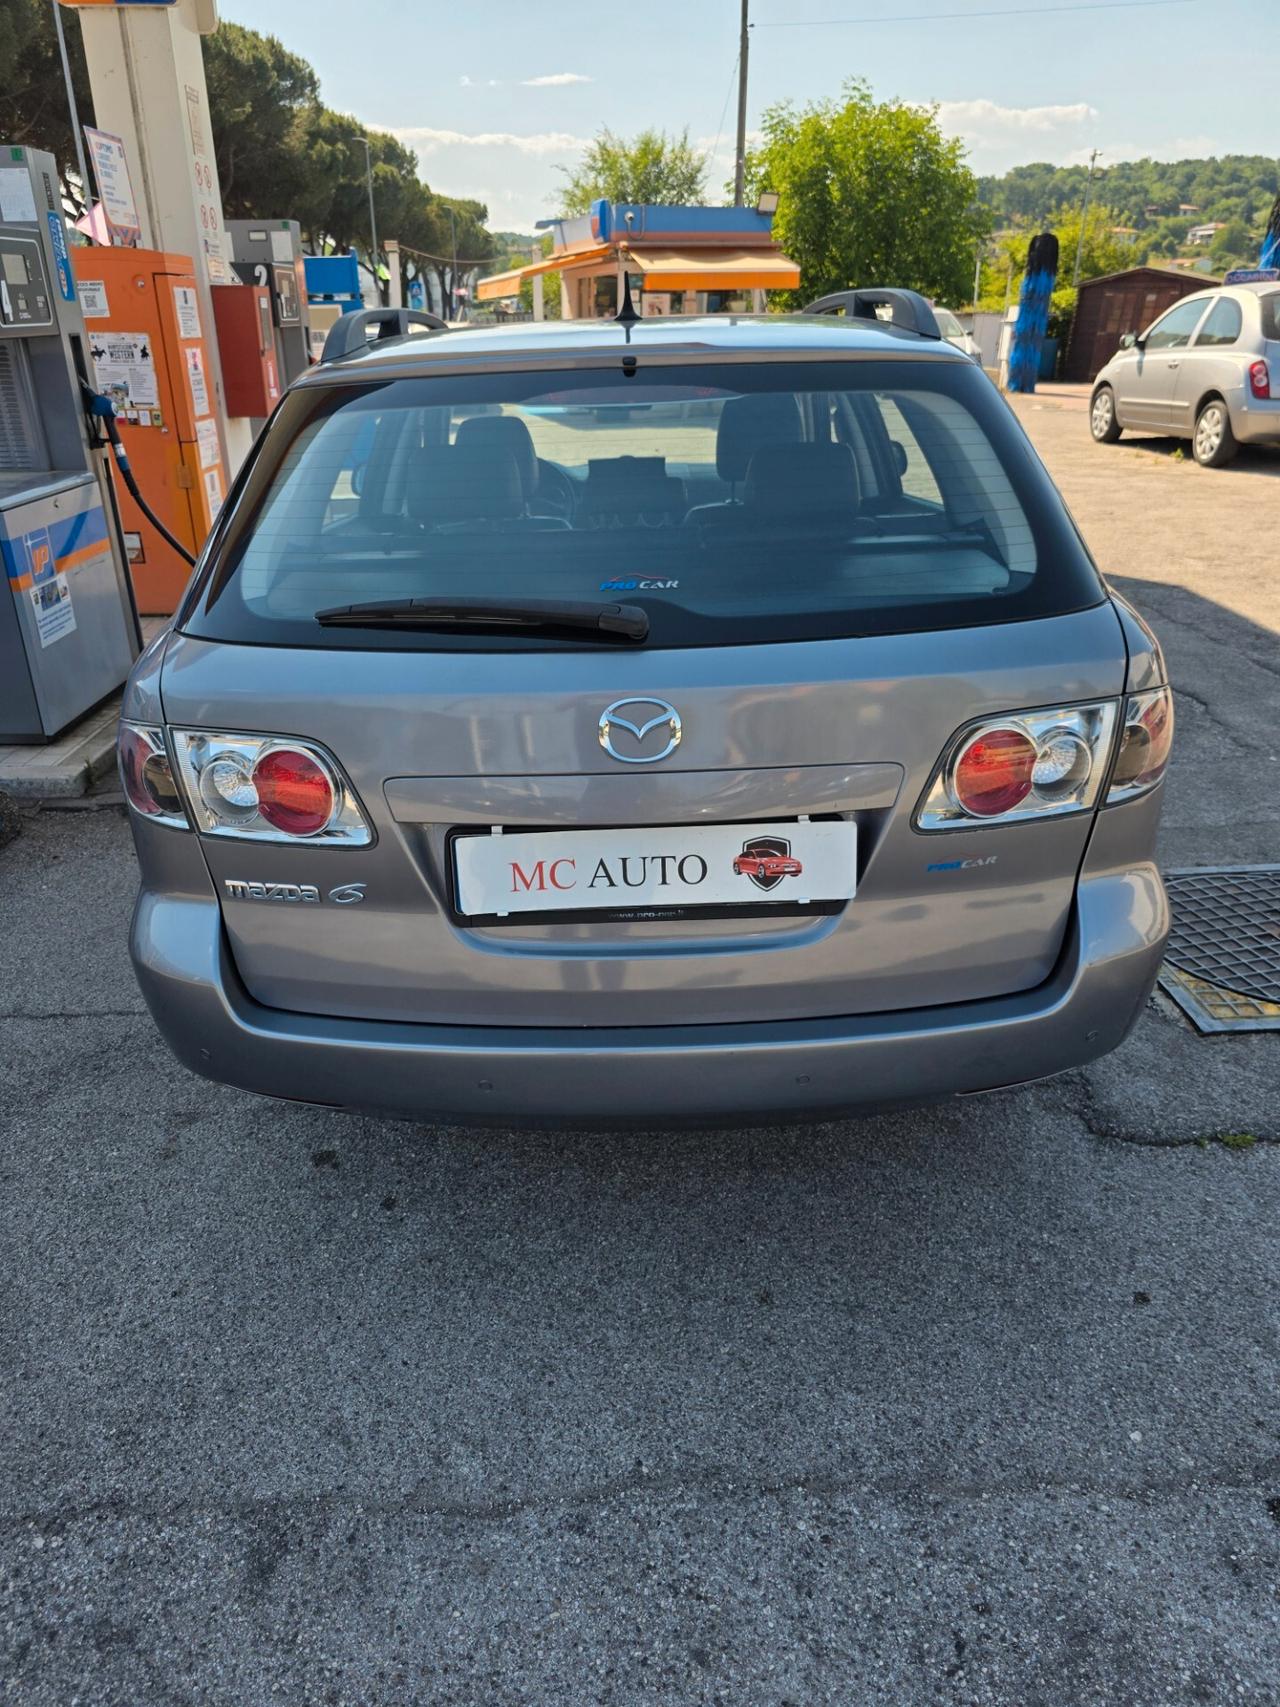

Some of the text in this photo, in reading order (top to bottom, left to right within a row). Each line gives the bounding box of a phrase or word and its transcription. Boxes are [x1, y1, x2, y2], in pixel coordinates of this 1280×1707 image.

[509, 853, 708, 892] MC AUTO
[327, 882, 368, 904] 6
